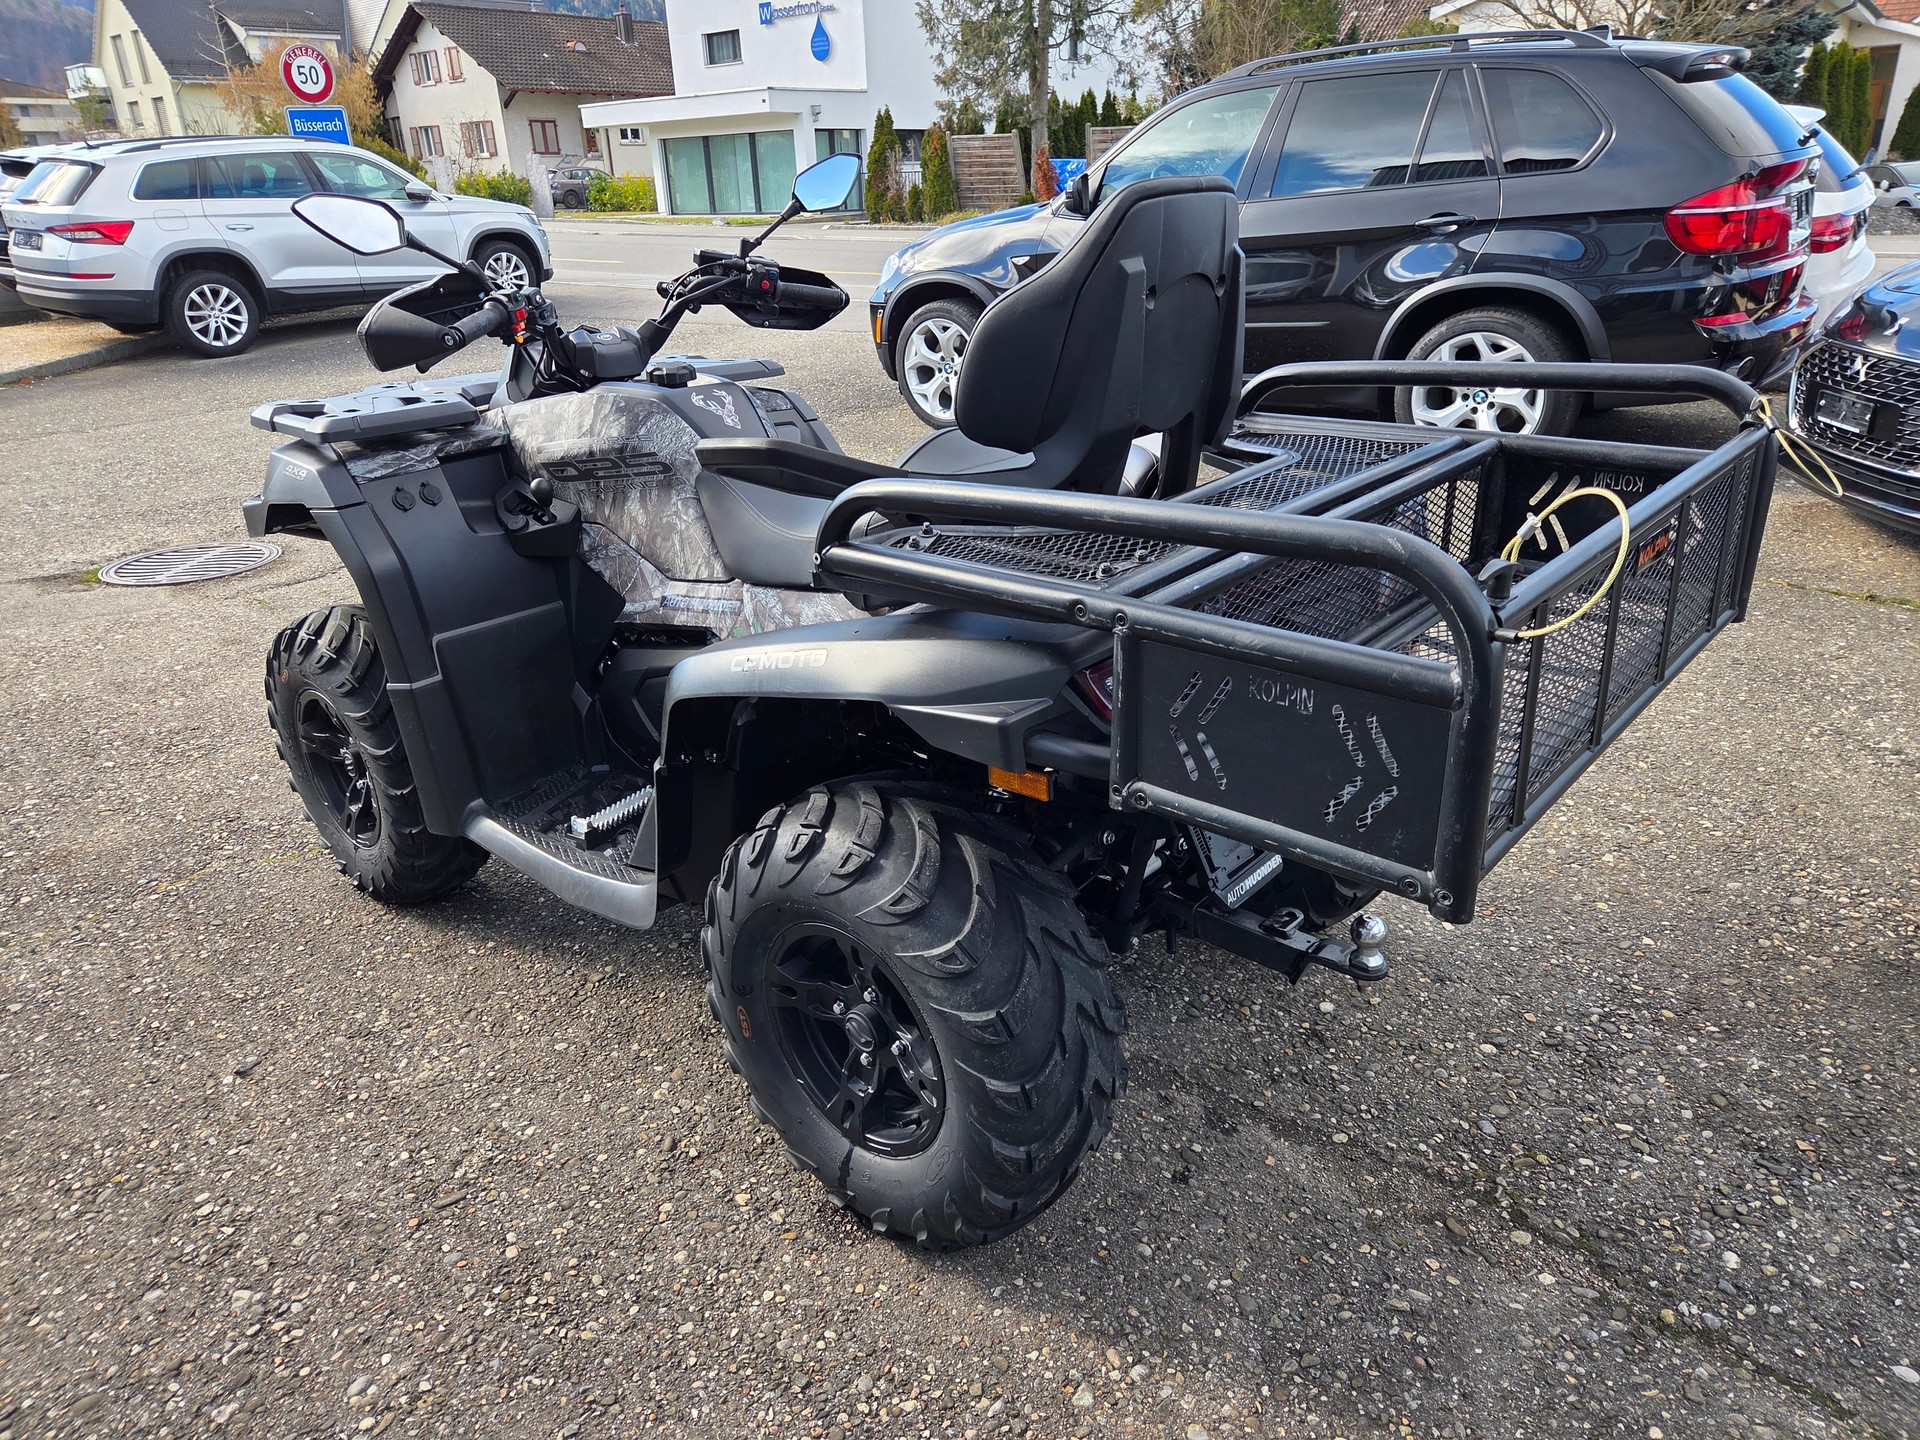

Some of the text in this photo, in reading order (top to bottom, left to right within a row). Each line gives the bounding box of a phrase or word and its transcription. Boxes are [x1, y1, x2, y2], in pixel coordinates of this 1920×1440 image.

[759, 0, 821, 21] Wasserfront
[285, 47, 327, 66] GENERELL
[296, 65, 320, 86] 50
[293, 117, 344, 132] Büsserach
[730, 649, 828, 672] CFMOTO
[1248, 674, 1315, 714] KOLPIN
[1227, 854, 1283, 906] AUTO HUONDER
